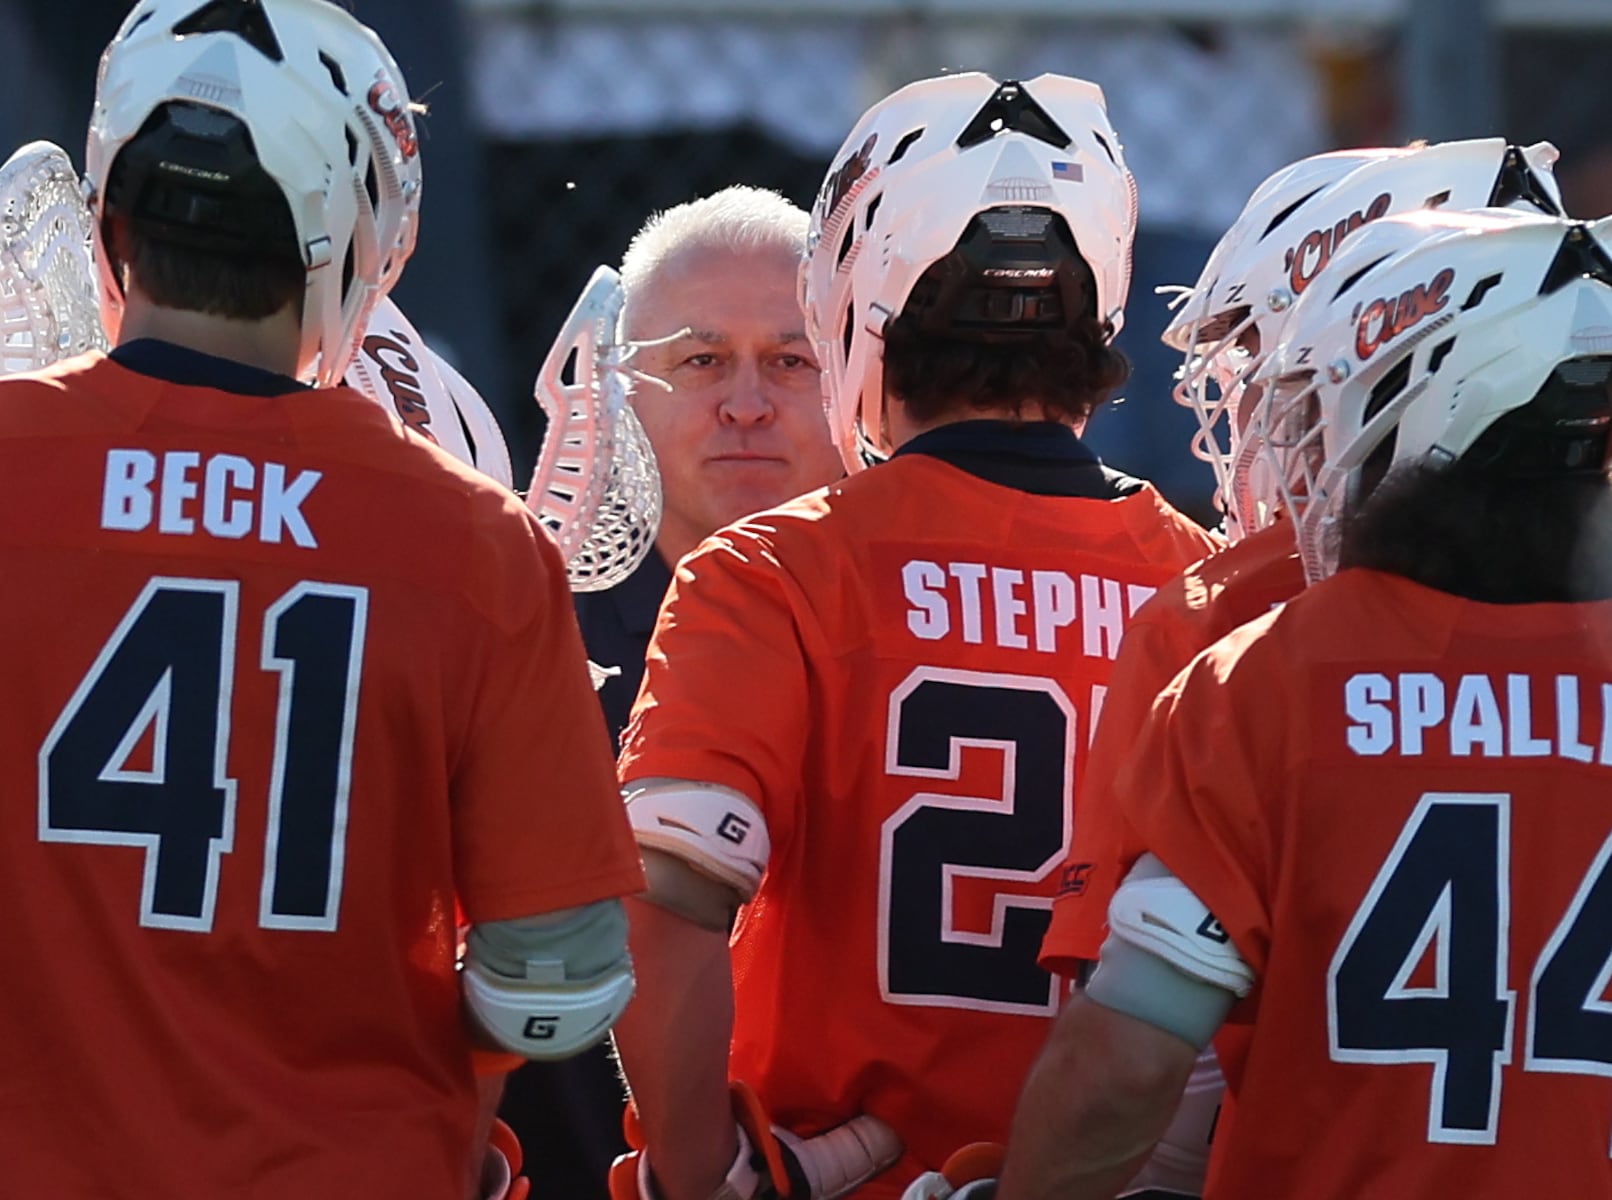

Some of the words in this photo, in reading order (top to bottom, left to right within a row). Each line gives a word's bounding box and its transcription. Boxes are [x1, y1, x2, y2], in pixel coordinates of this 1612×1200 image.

[1351, 268, 1455, 360] 'Cuse
[362, 329, 440, 446] 'Cus
[102, 448, 323, 548] BECK
[902, 560, 1158, 661] STEPH
[38, 576, 369, 932] 41
[717, 811, 751, 845] G
[878, 665, 1108, 1017] 2
[523, 1015, 560, 1040] G
